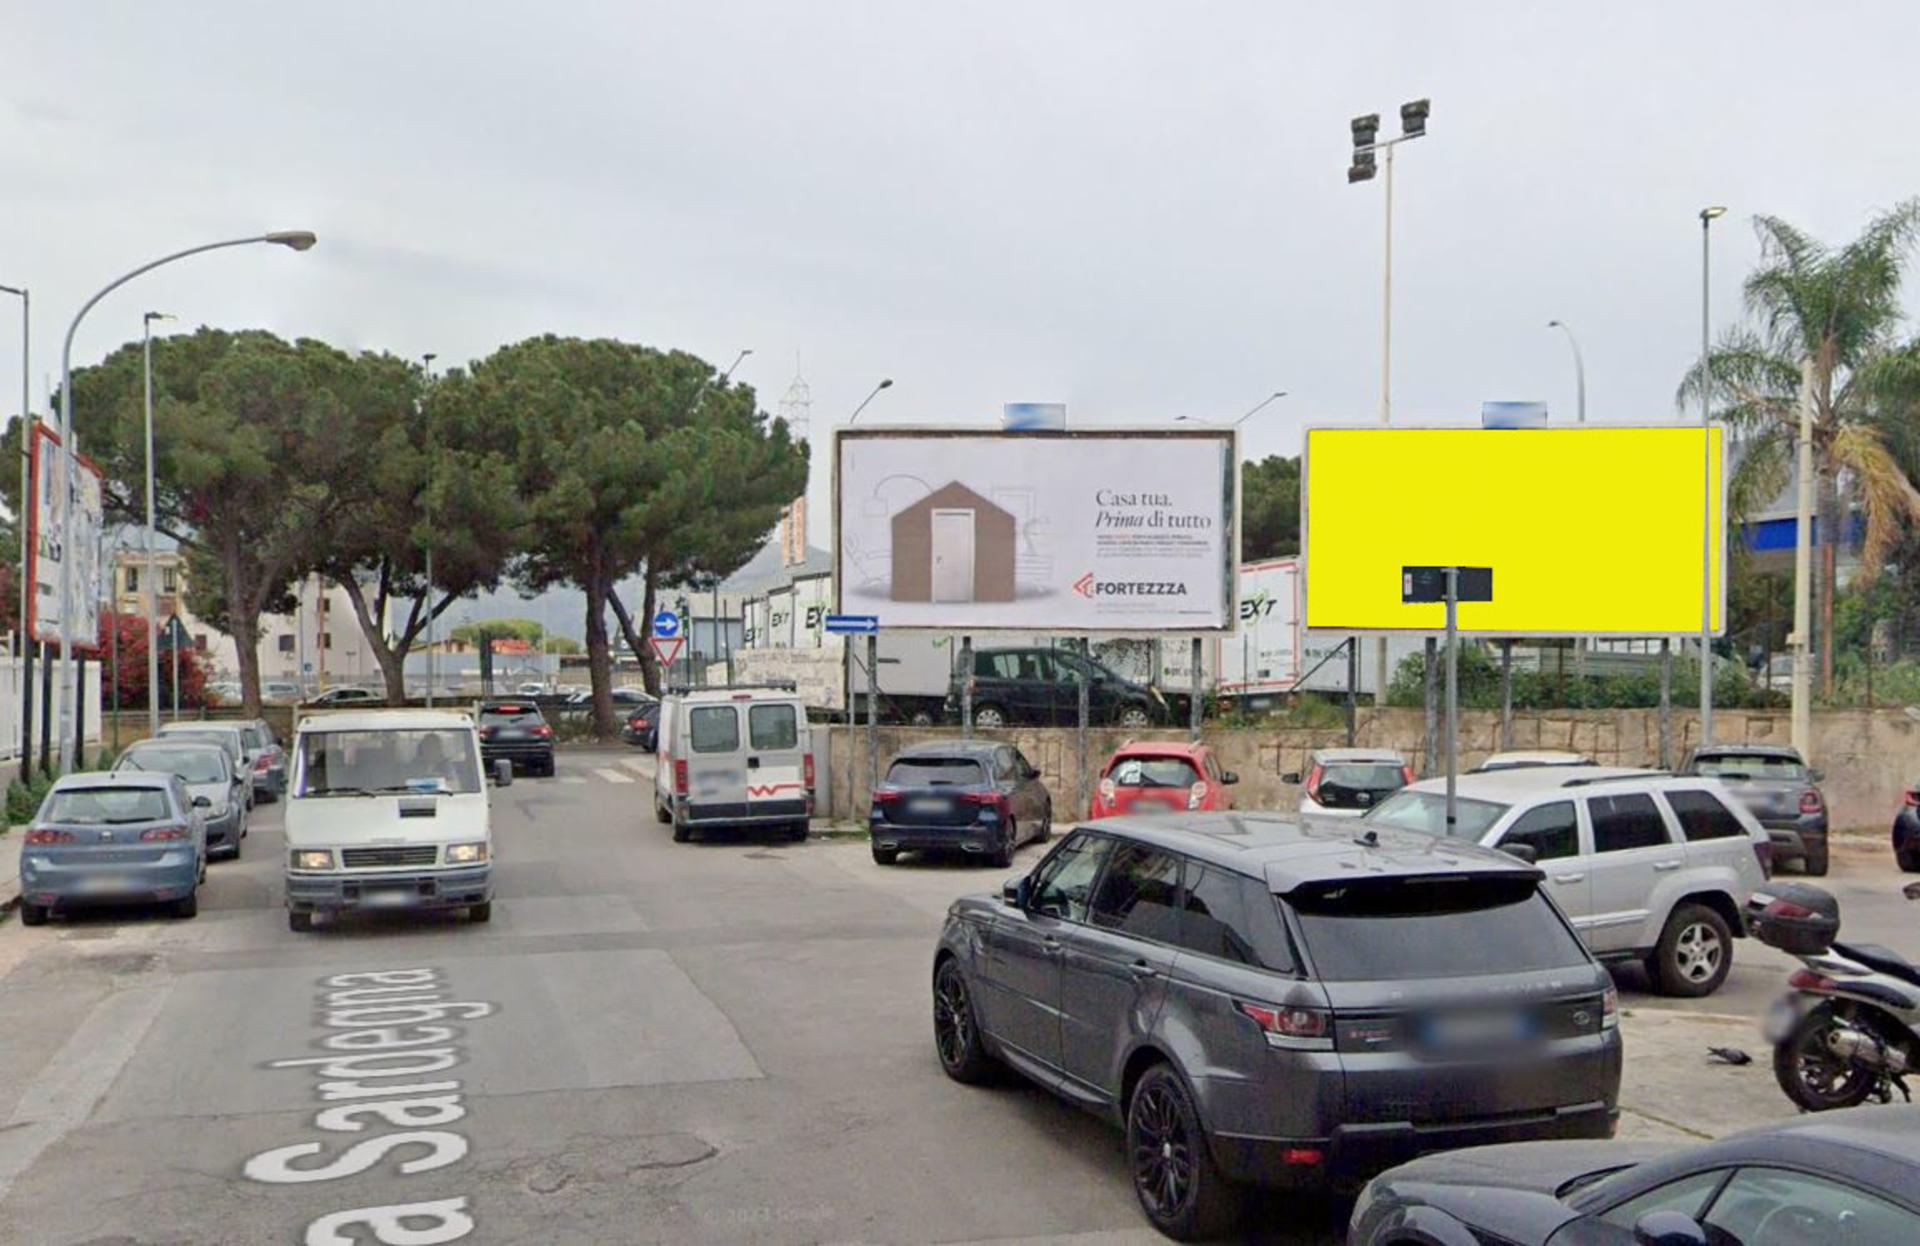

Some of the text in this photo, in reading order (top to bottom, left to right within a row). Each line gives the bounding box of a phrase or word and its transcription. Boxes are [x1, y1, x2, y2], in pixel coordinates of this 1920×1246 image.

[1096, 490, 1172, 506] Casa tua.
[1095, 510, 1212, 528] Prima di tutto
[1096, 582, 1187, 595] FORTEZZZA
[805, 606, 831, 629] EX
[244, 968, 490, 1184] Sardegna
